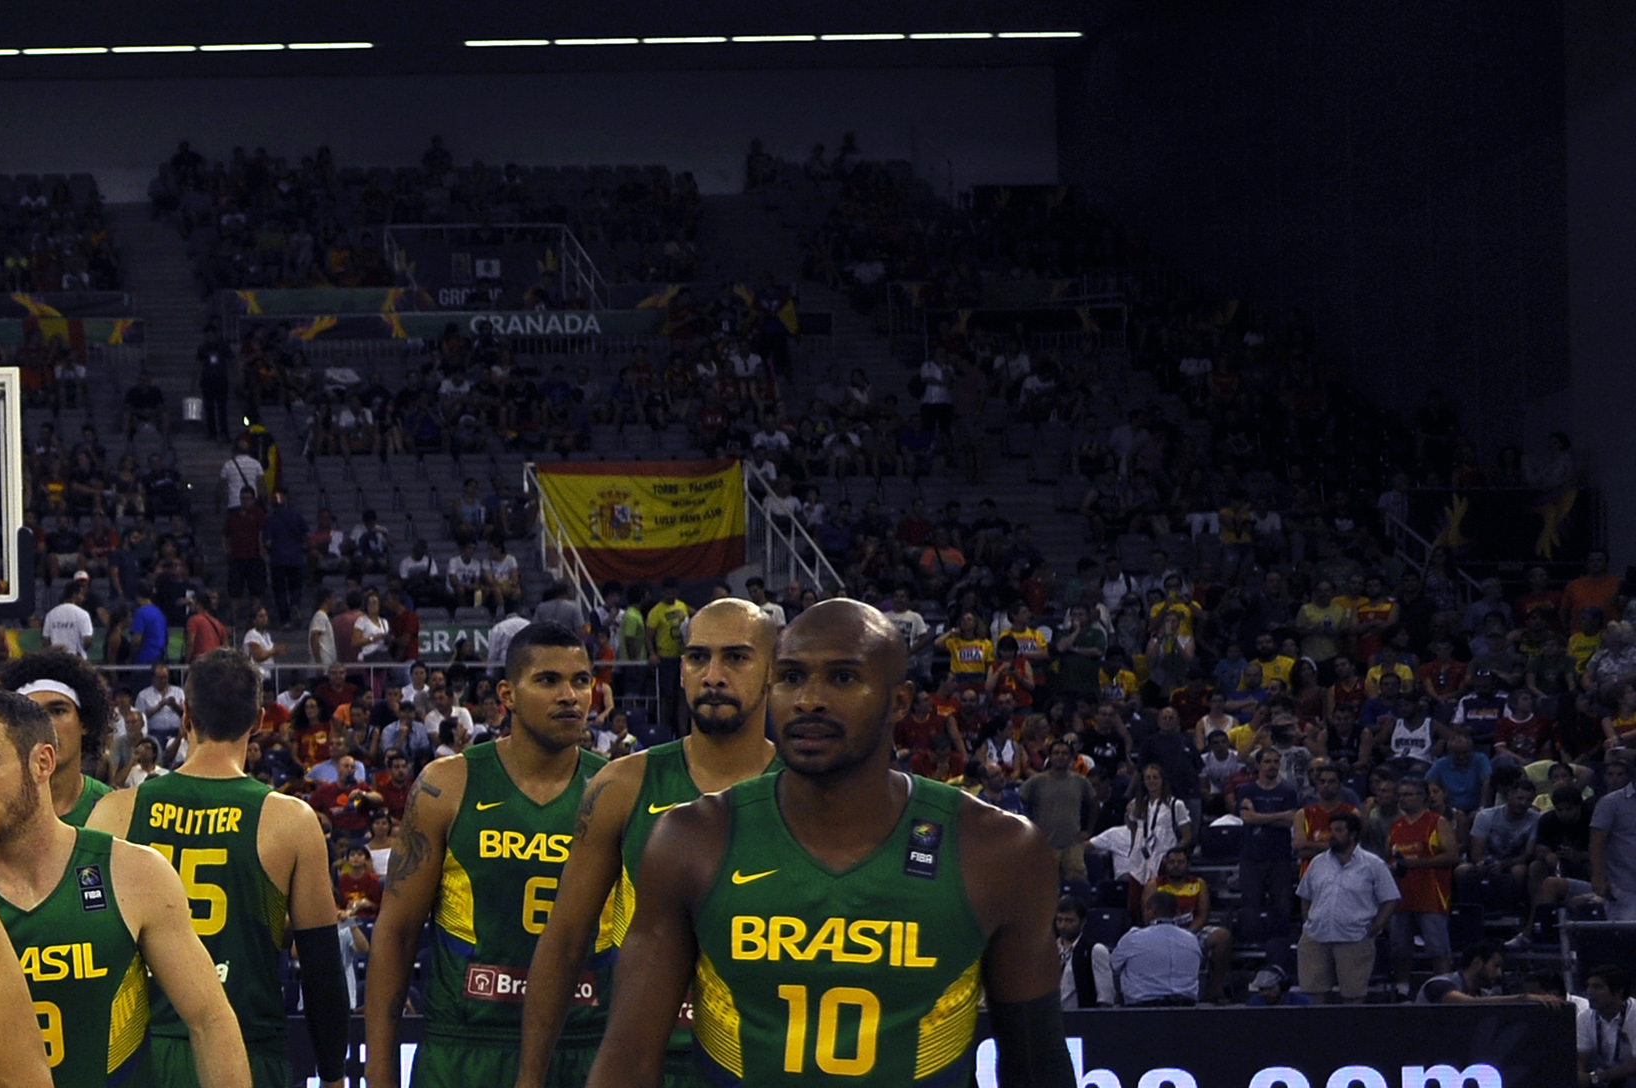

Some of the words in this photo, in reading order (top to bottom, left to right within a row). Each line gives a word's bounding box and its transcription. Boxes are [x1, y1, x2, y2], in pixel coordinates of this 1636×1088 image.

[150, 803, 242, 835] SPLITTER
[910, 851, 934, 865] FIBA
[150, 843, 228, 936] 5
[522, 876, 559, 935] 6
[731, 915, 938, 968] BRASIL
[778, 984, 881, 1077] 10
